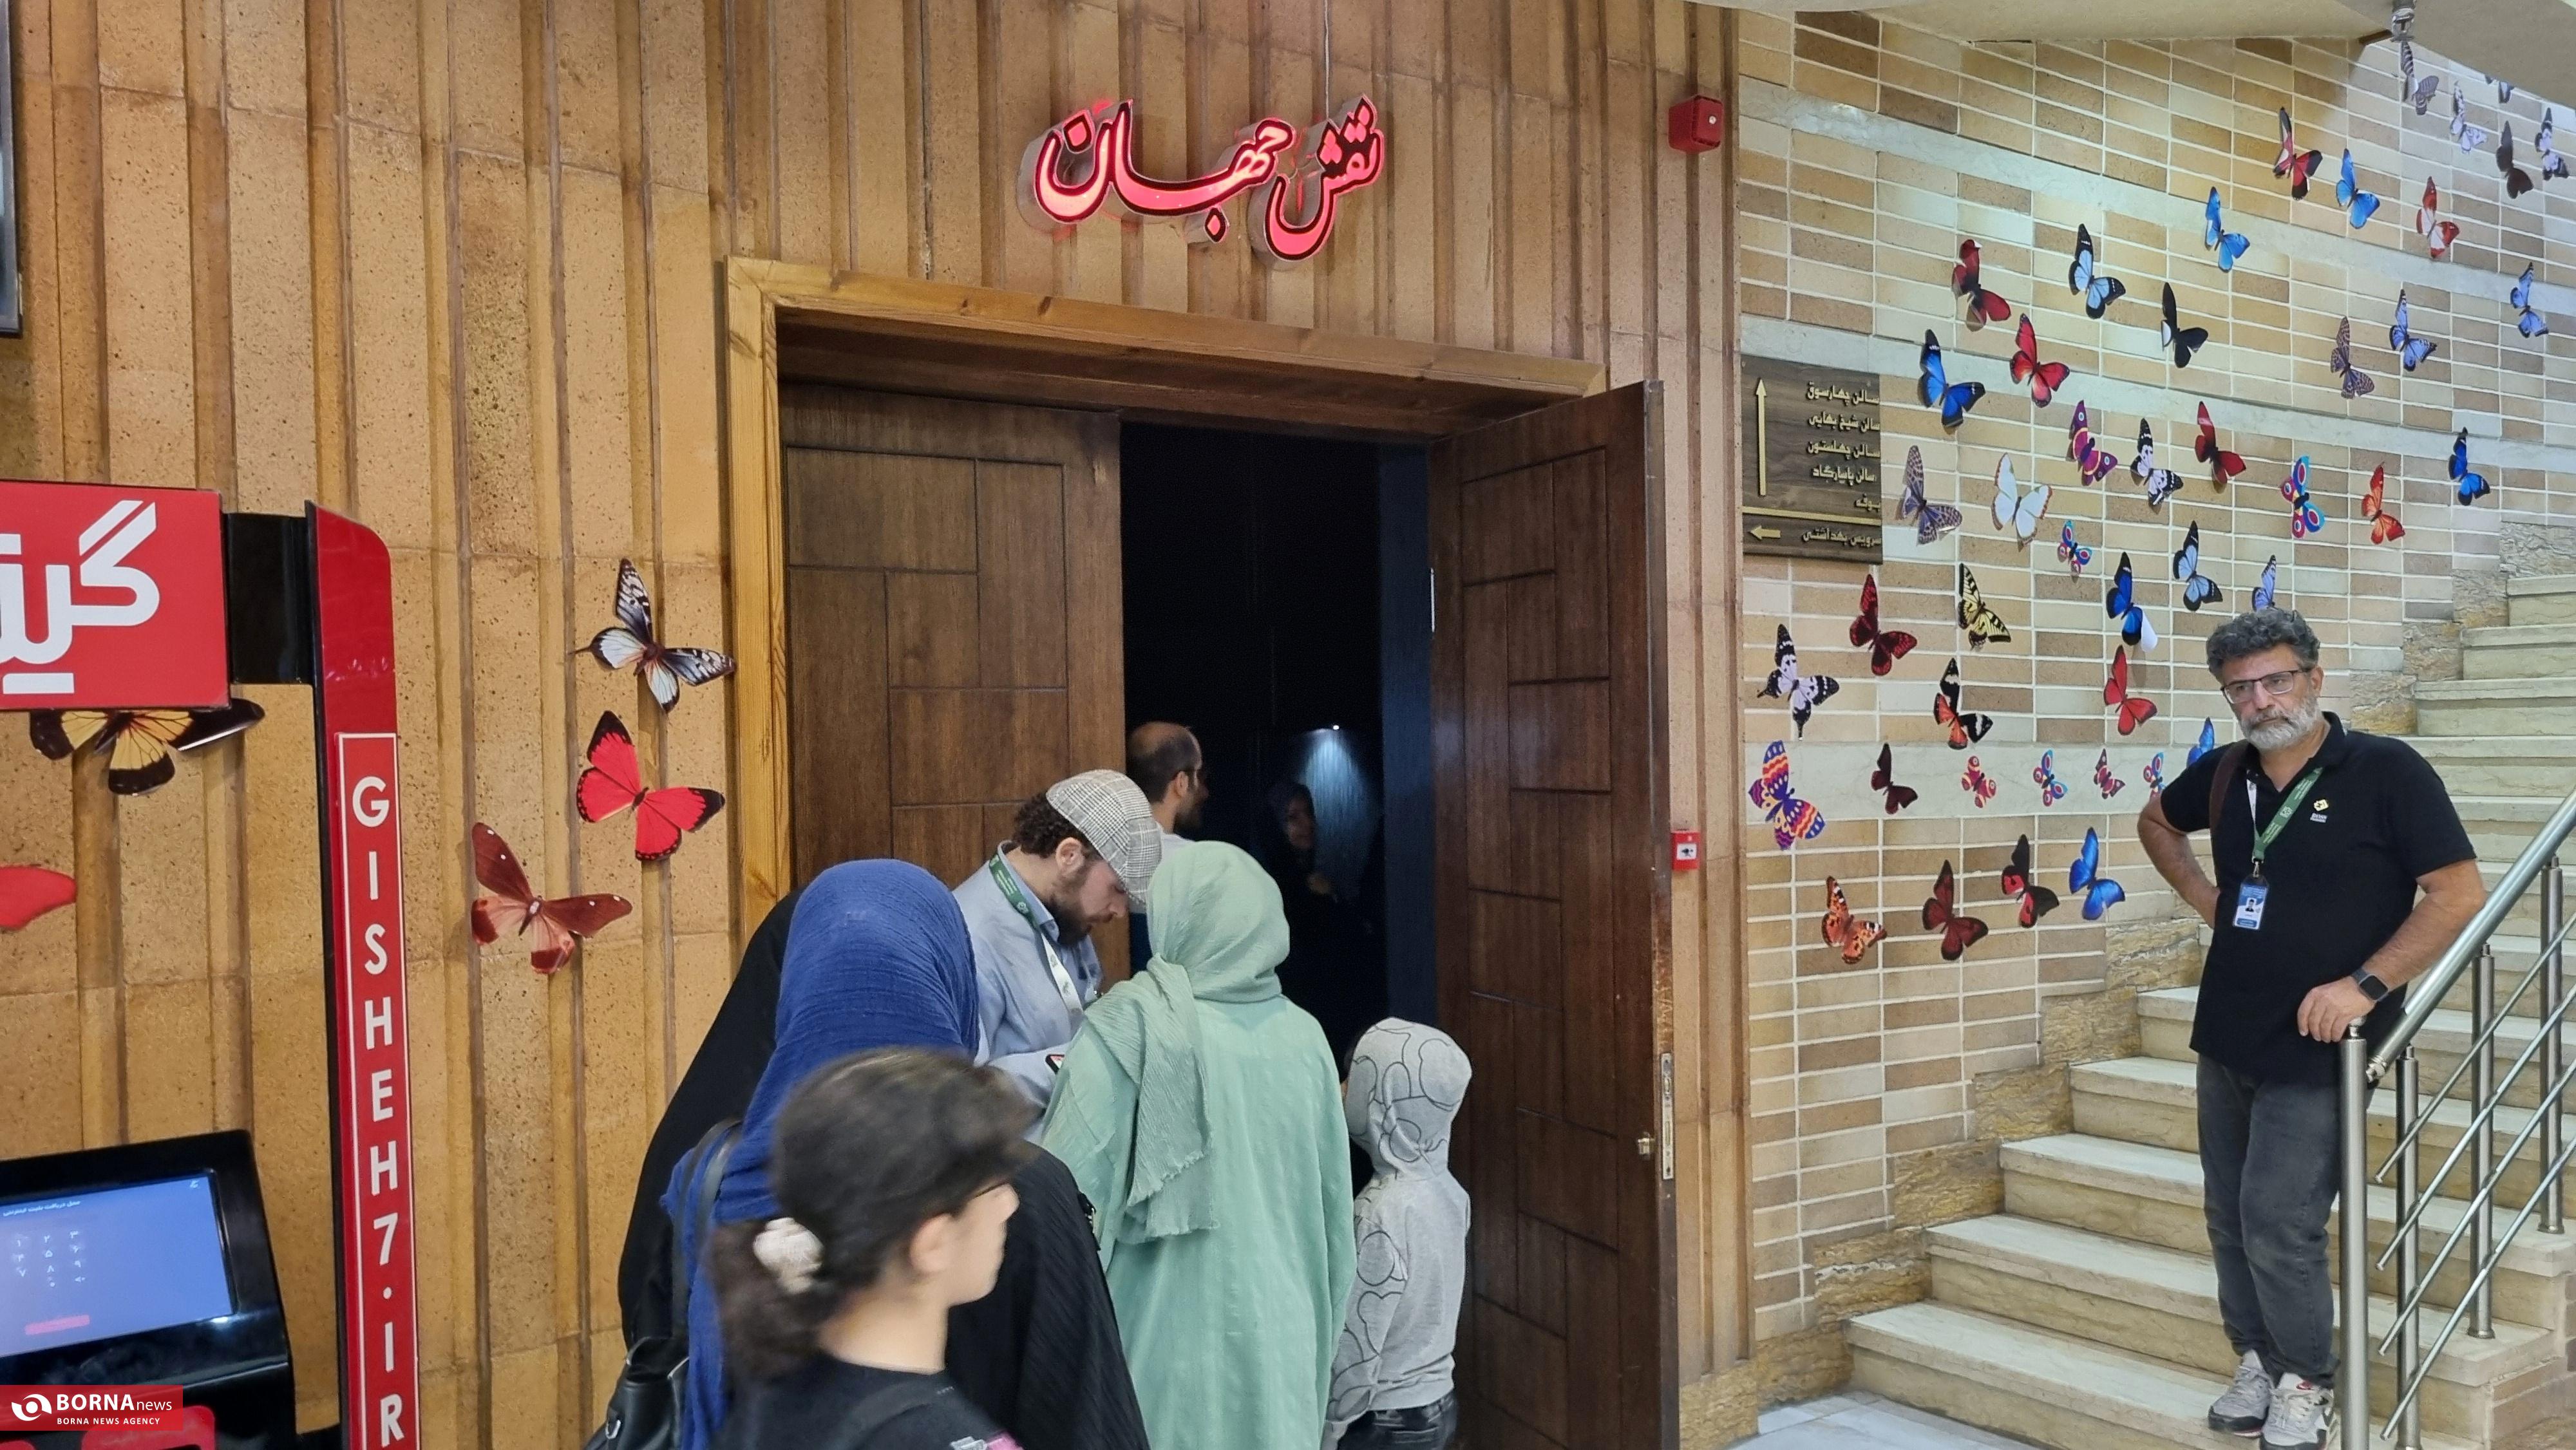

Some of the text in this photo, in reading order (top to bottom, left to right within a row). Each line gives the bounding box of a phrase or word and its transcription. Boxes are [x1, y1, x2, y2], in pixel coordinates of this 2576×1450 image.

[1034, 93, 1385, 261] نقش جهان
[1807, 381, 1880, 406] سالن چهارسوق
[1839, 414, 1859, 431] شیخ
[1861, 417, 1880, 433] سالن
[1808, 440, 1881, 460] سالن چهلستون
[1855, 468, 1877, 484] سالن
